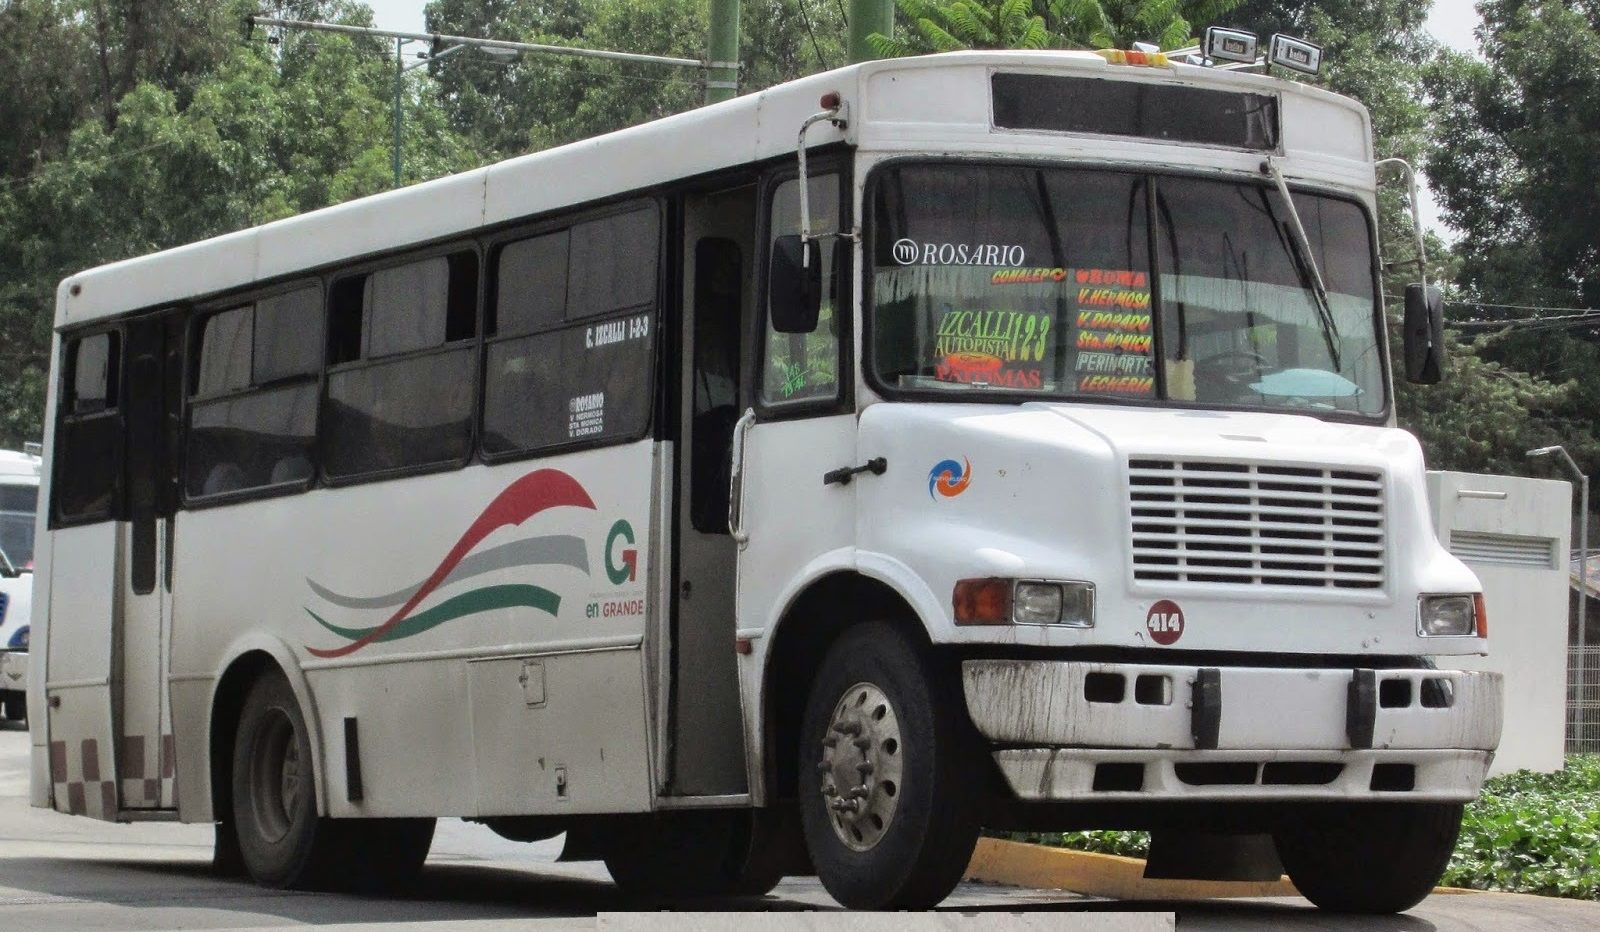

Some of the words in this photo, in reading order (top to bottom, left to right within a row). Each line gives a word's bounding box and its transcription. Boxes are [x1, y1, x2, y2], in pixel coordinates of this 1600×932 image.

[921, 243, 1025, 267] ROSARIO
[595, 320, 626, 346] IZCALLI
[936, 311, 1017, 340] IZCALLI
[934, 336, 1010, 362] AUTOPISTA
[575, 392, 604, 412] ROSARIO
[576, 424, 603, 436] DORADO
[586, 602, 599, 618] en
[603, 600, 644, 617] GRANDE
[1149, 613, 1180, 632] 414
